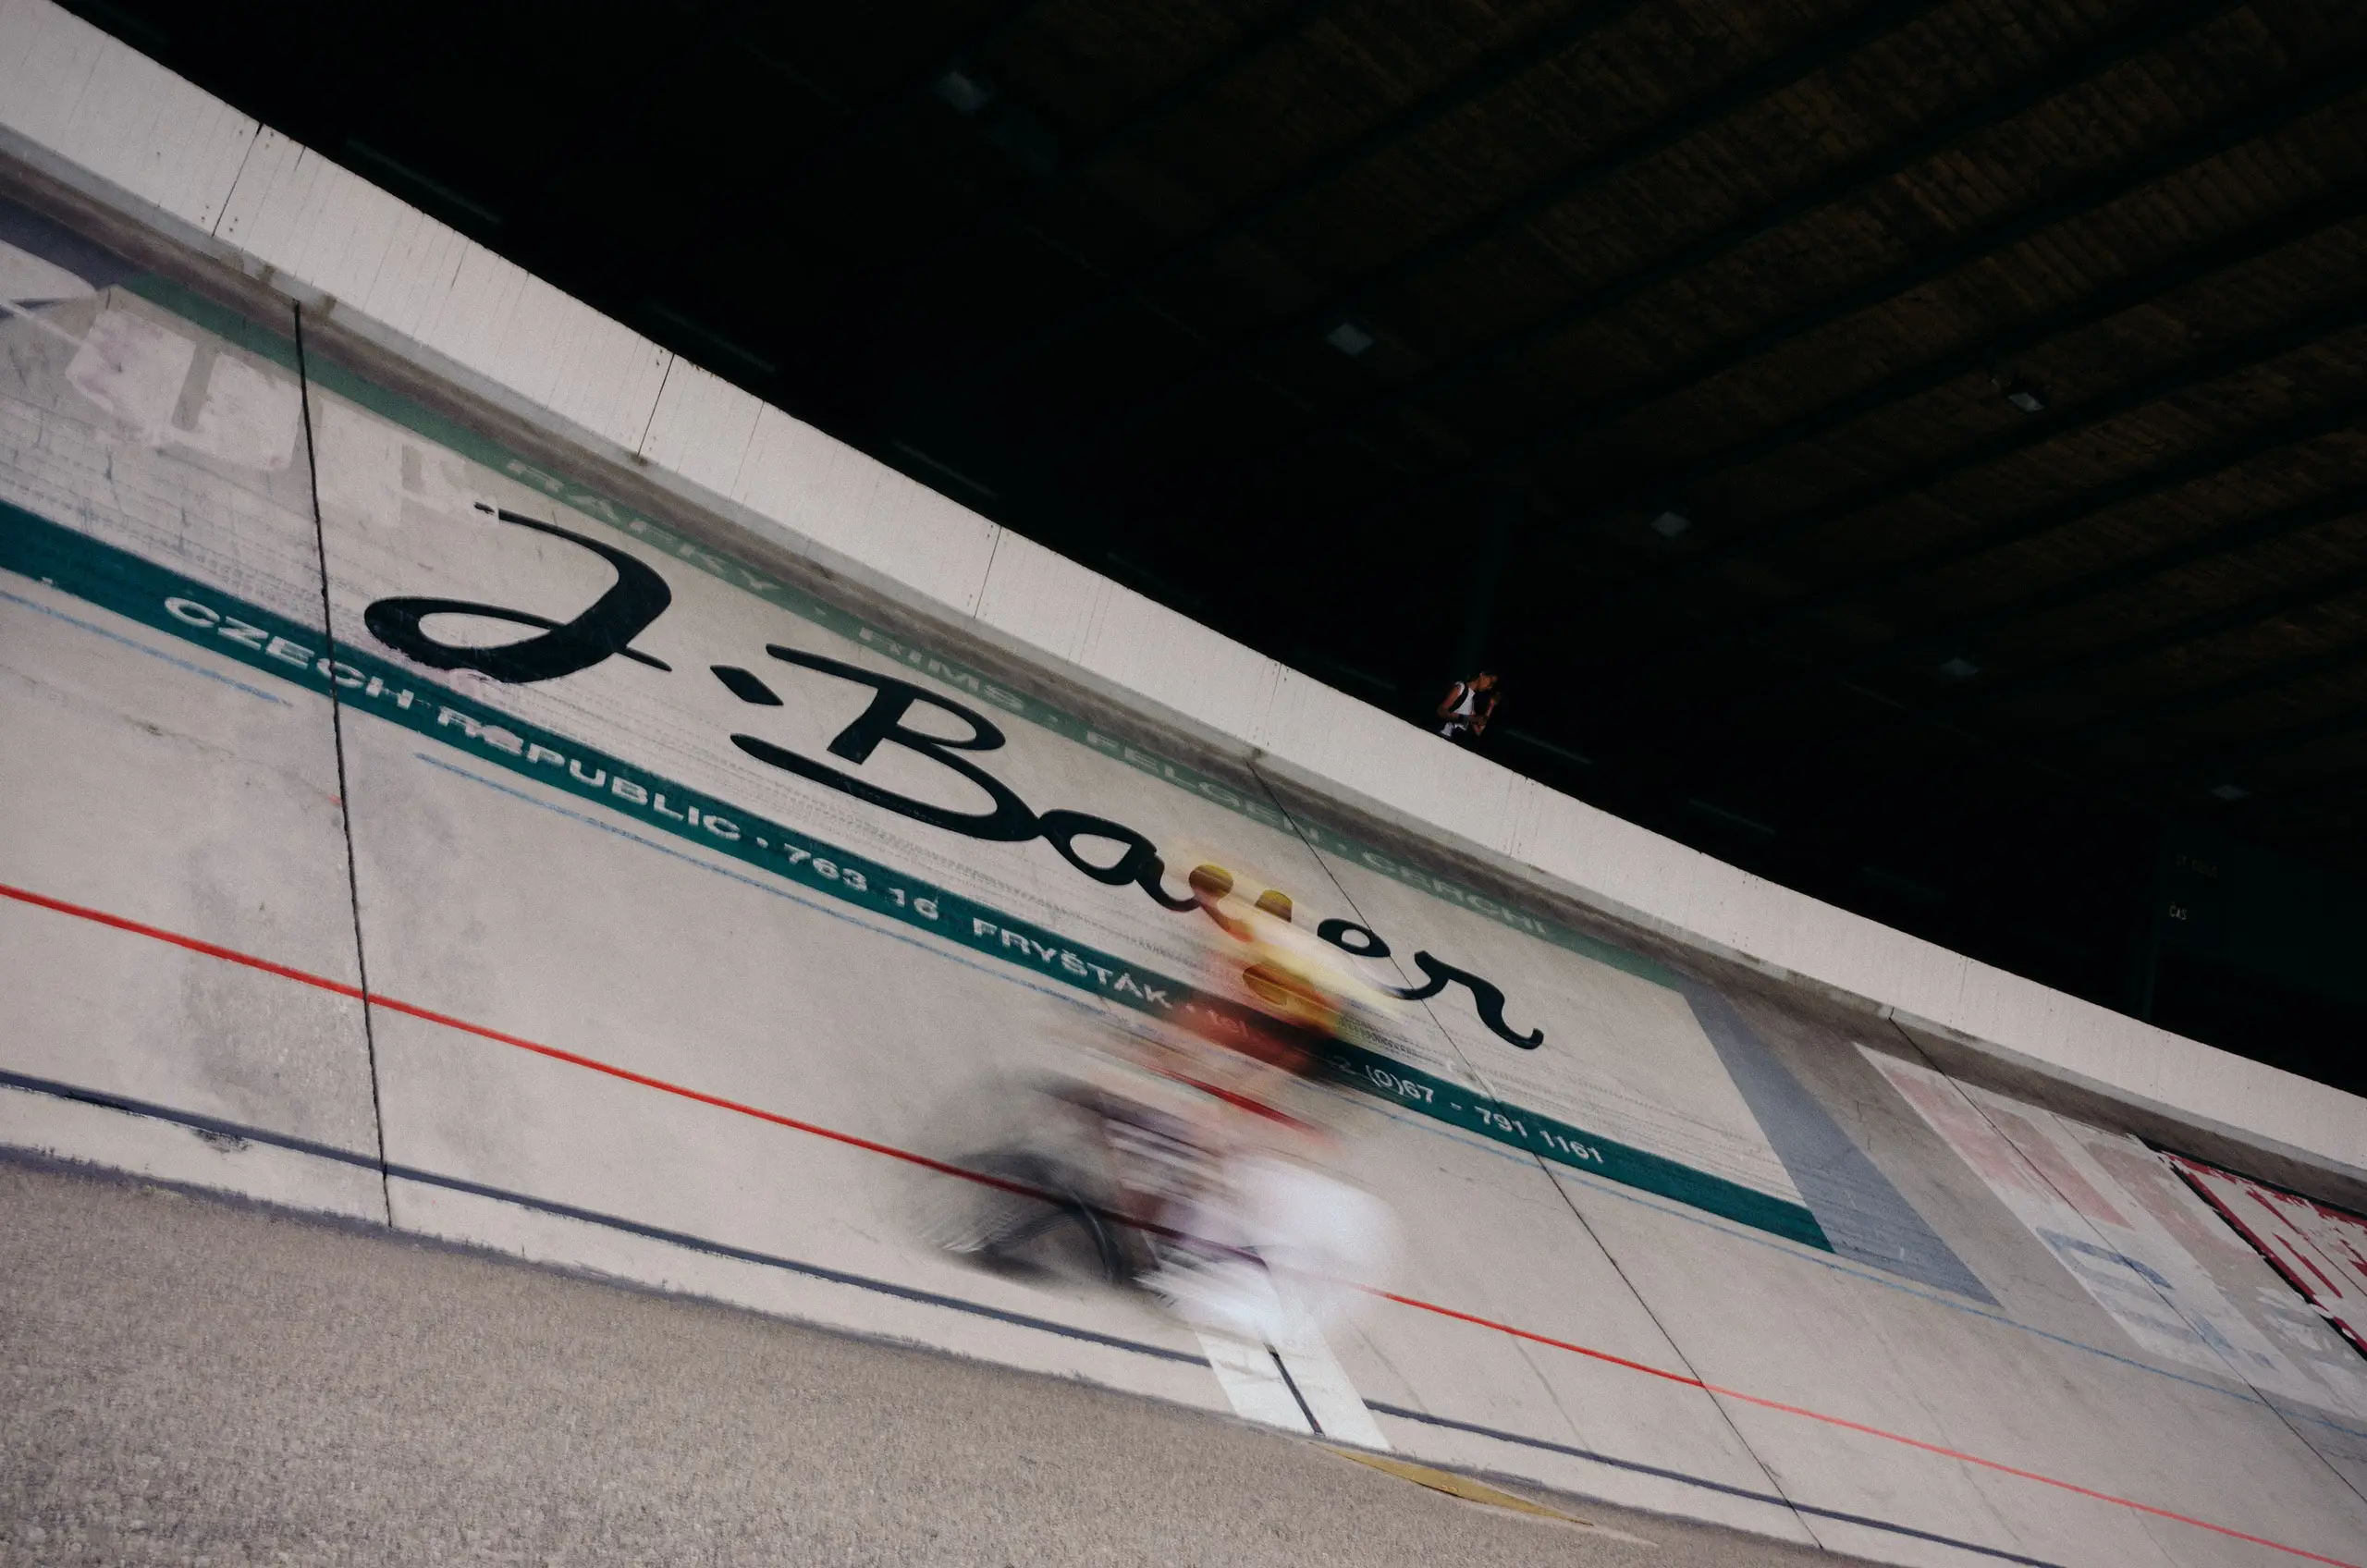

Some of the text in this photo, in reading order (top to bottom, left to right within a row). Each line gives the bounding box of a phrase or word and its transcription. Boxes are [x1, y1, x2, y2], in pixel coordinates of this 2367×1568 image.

[164, 596, 415, 710] CZECH
[782, 832, 870, 895] 763
[889, 887, 941, 922] 16
[971, 915, 1174, 1010] FRYŠTÁK
[1364, 1063, 1435, 1104] (0)67
[1474, 1105, 1528, 1139] 791
[1539, 1128, 1607, 1165] 1161
[859, 626, 1024, 713] RIMS
[1086, 729, 1318, 845] FELGEN
[1360, 850, 1549, 938] CERCHI
